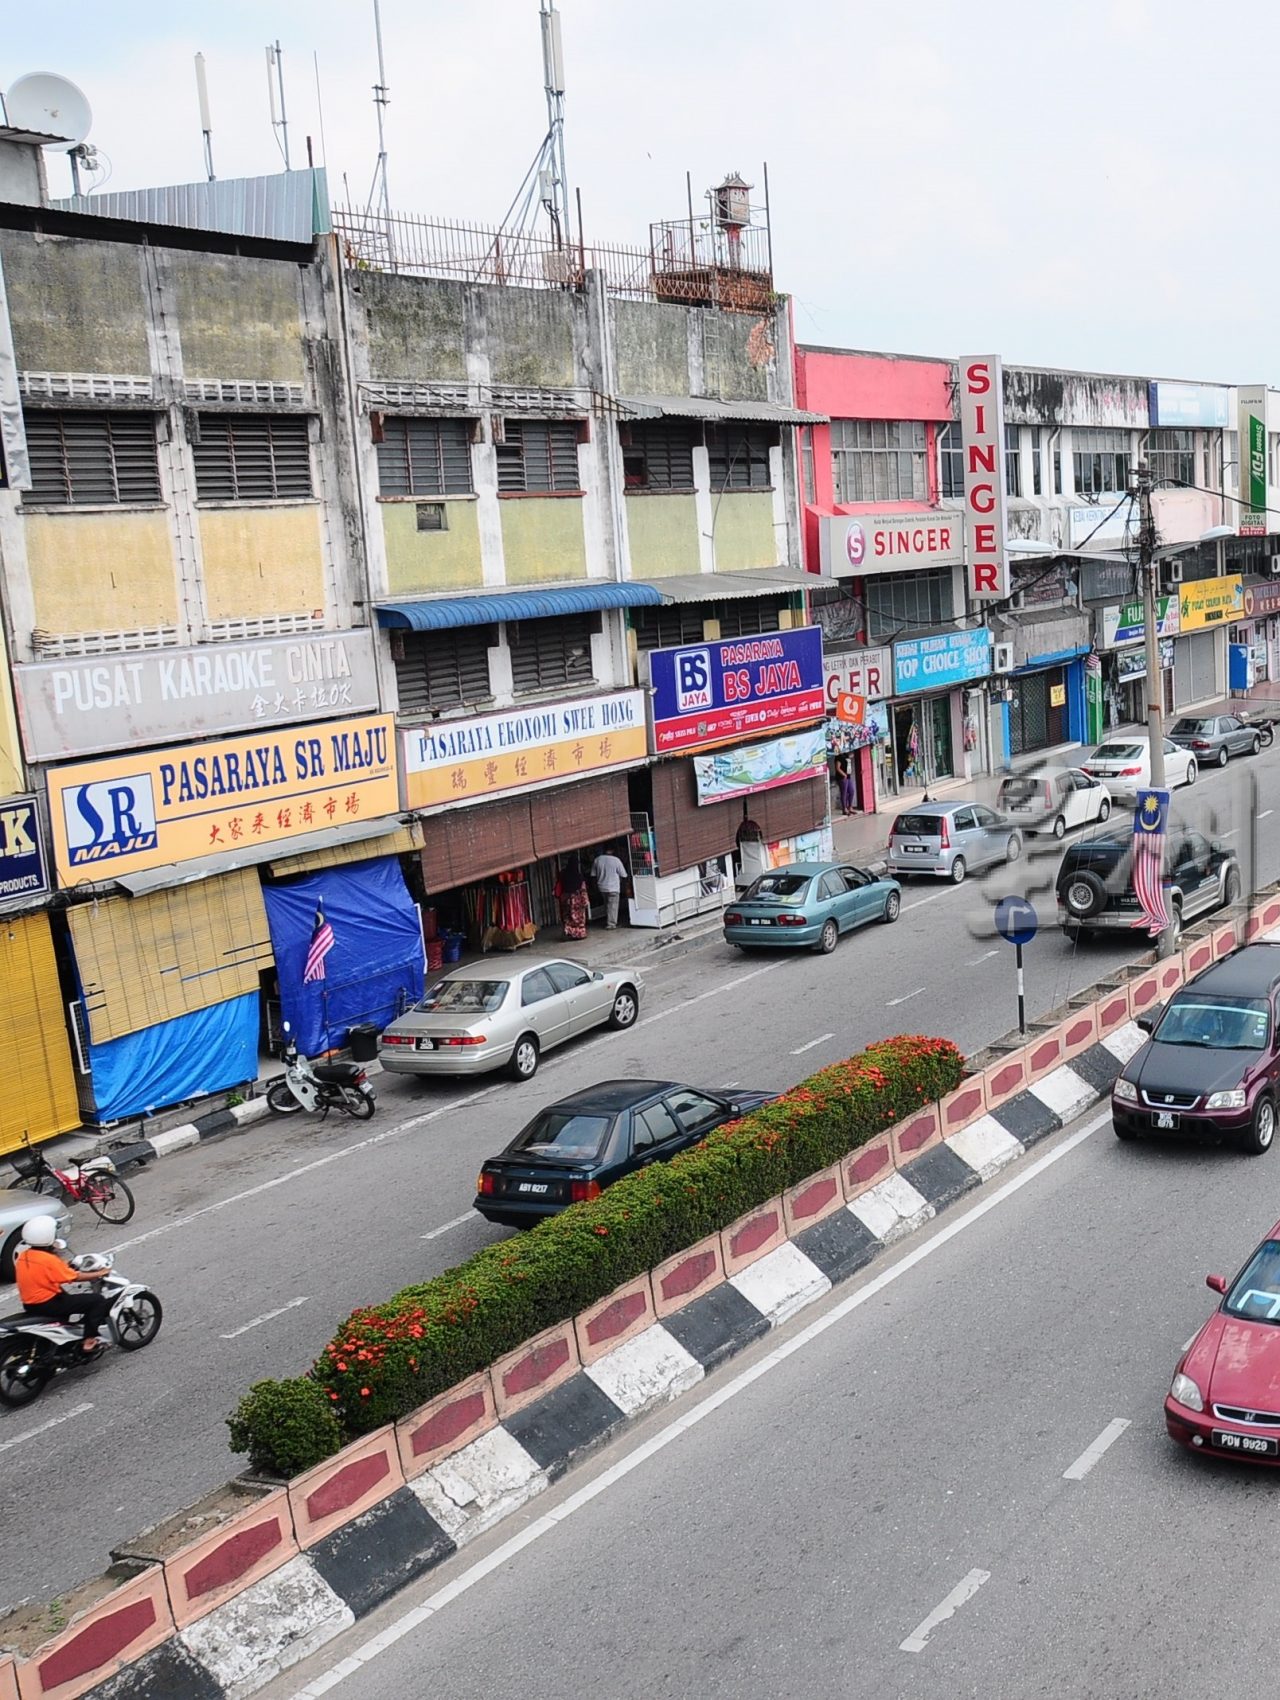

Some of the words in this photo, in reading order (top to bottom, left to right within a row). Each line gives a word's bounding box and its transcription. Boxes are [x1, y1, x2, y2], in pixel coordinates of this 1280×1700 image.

[967, 364, 998, 592] SINGER
[875, 528, 951, 557] SINGER
[721, 638, 784, 667] PASARAYA
[849, 657, 859, 668] DAN
[860, 654, 880, 666] PERABOT
[897, 658, 919, 680] TOP
[922, 650, 961, 675] CHOICE
[963, 645, 990, 666] SHOP
[52, 661, 146, 715] PUSAT
[159, 647, 276, 702] KARAOKE
[286, 640, 352, 683] CINTA
[679, 654, 708, 694] BS
[723, 669, 750, 702] BS
[755, 660, 802, 696] JAYA
[681, 691, 708, 708] JAYA
[419, 724, 494, 763] PASARAYA
[498, 713, 557, 748] EKONOMI
[563, 705, 596, 736] SWEE
[602, 698, 635, 727] HONG
[160, 744, 287, 806] PASARAYA
[294, 739, 326, 780] SR
[331, 726, 388, 774] MAJU
[76, 783, 143, 849] SR
[73, 832, 155, 863] MAJU
[1222, 1434, 1240, 1448] PDW
